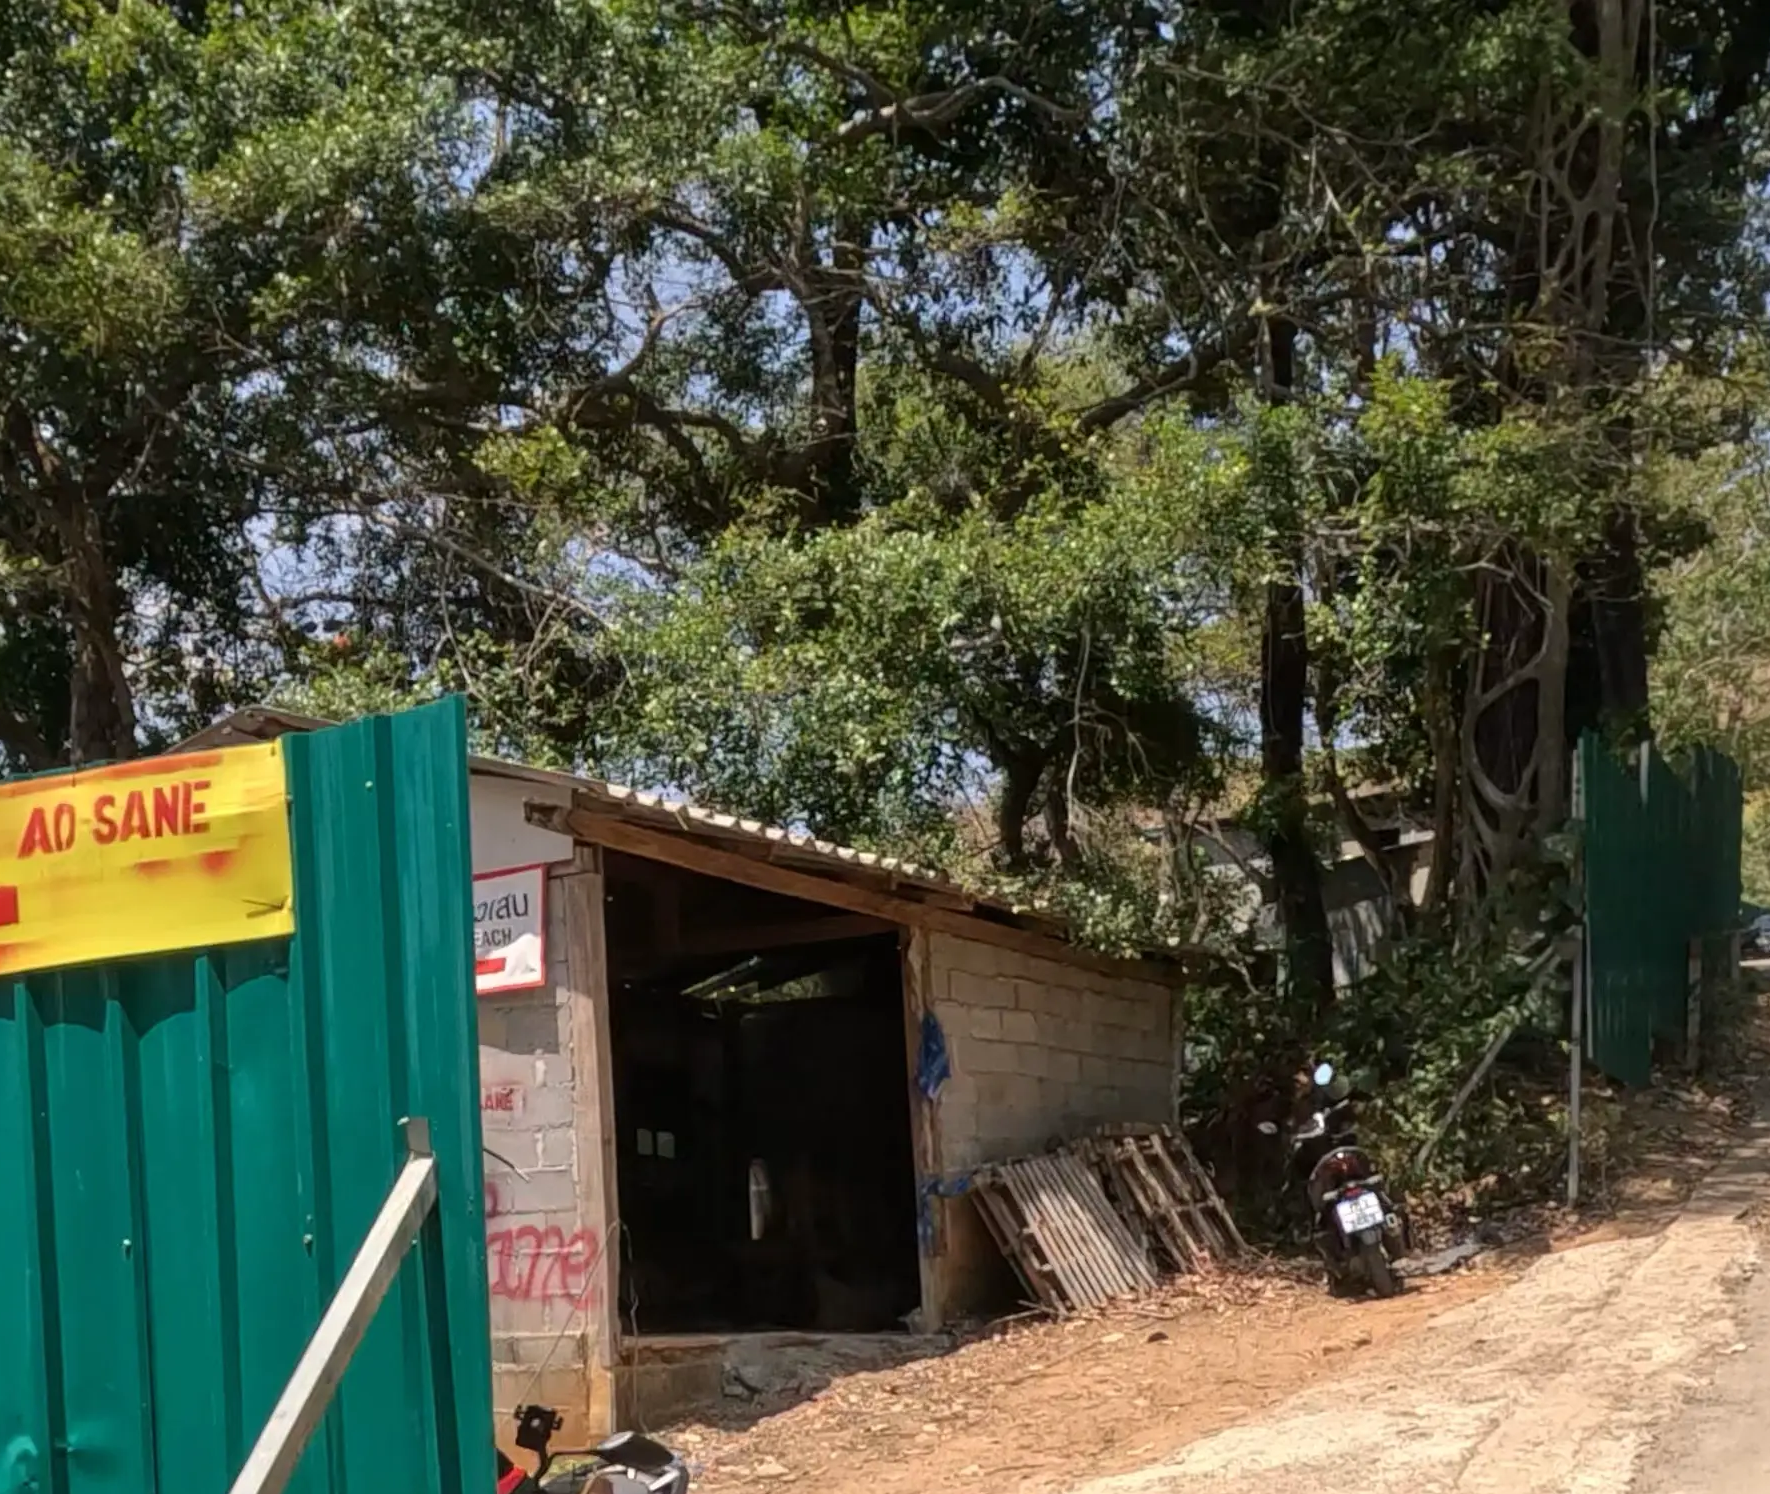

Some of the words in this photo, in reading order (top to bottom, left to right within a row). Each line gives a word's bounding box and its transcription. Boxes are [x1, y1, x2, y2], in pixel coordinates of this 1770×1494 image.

[17, 802, 76, 860] AO
[92, 780, 211, 845] SANE
[473, 892, 528, 922] วเสน
[473, 927, 512, 948] EACH
